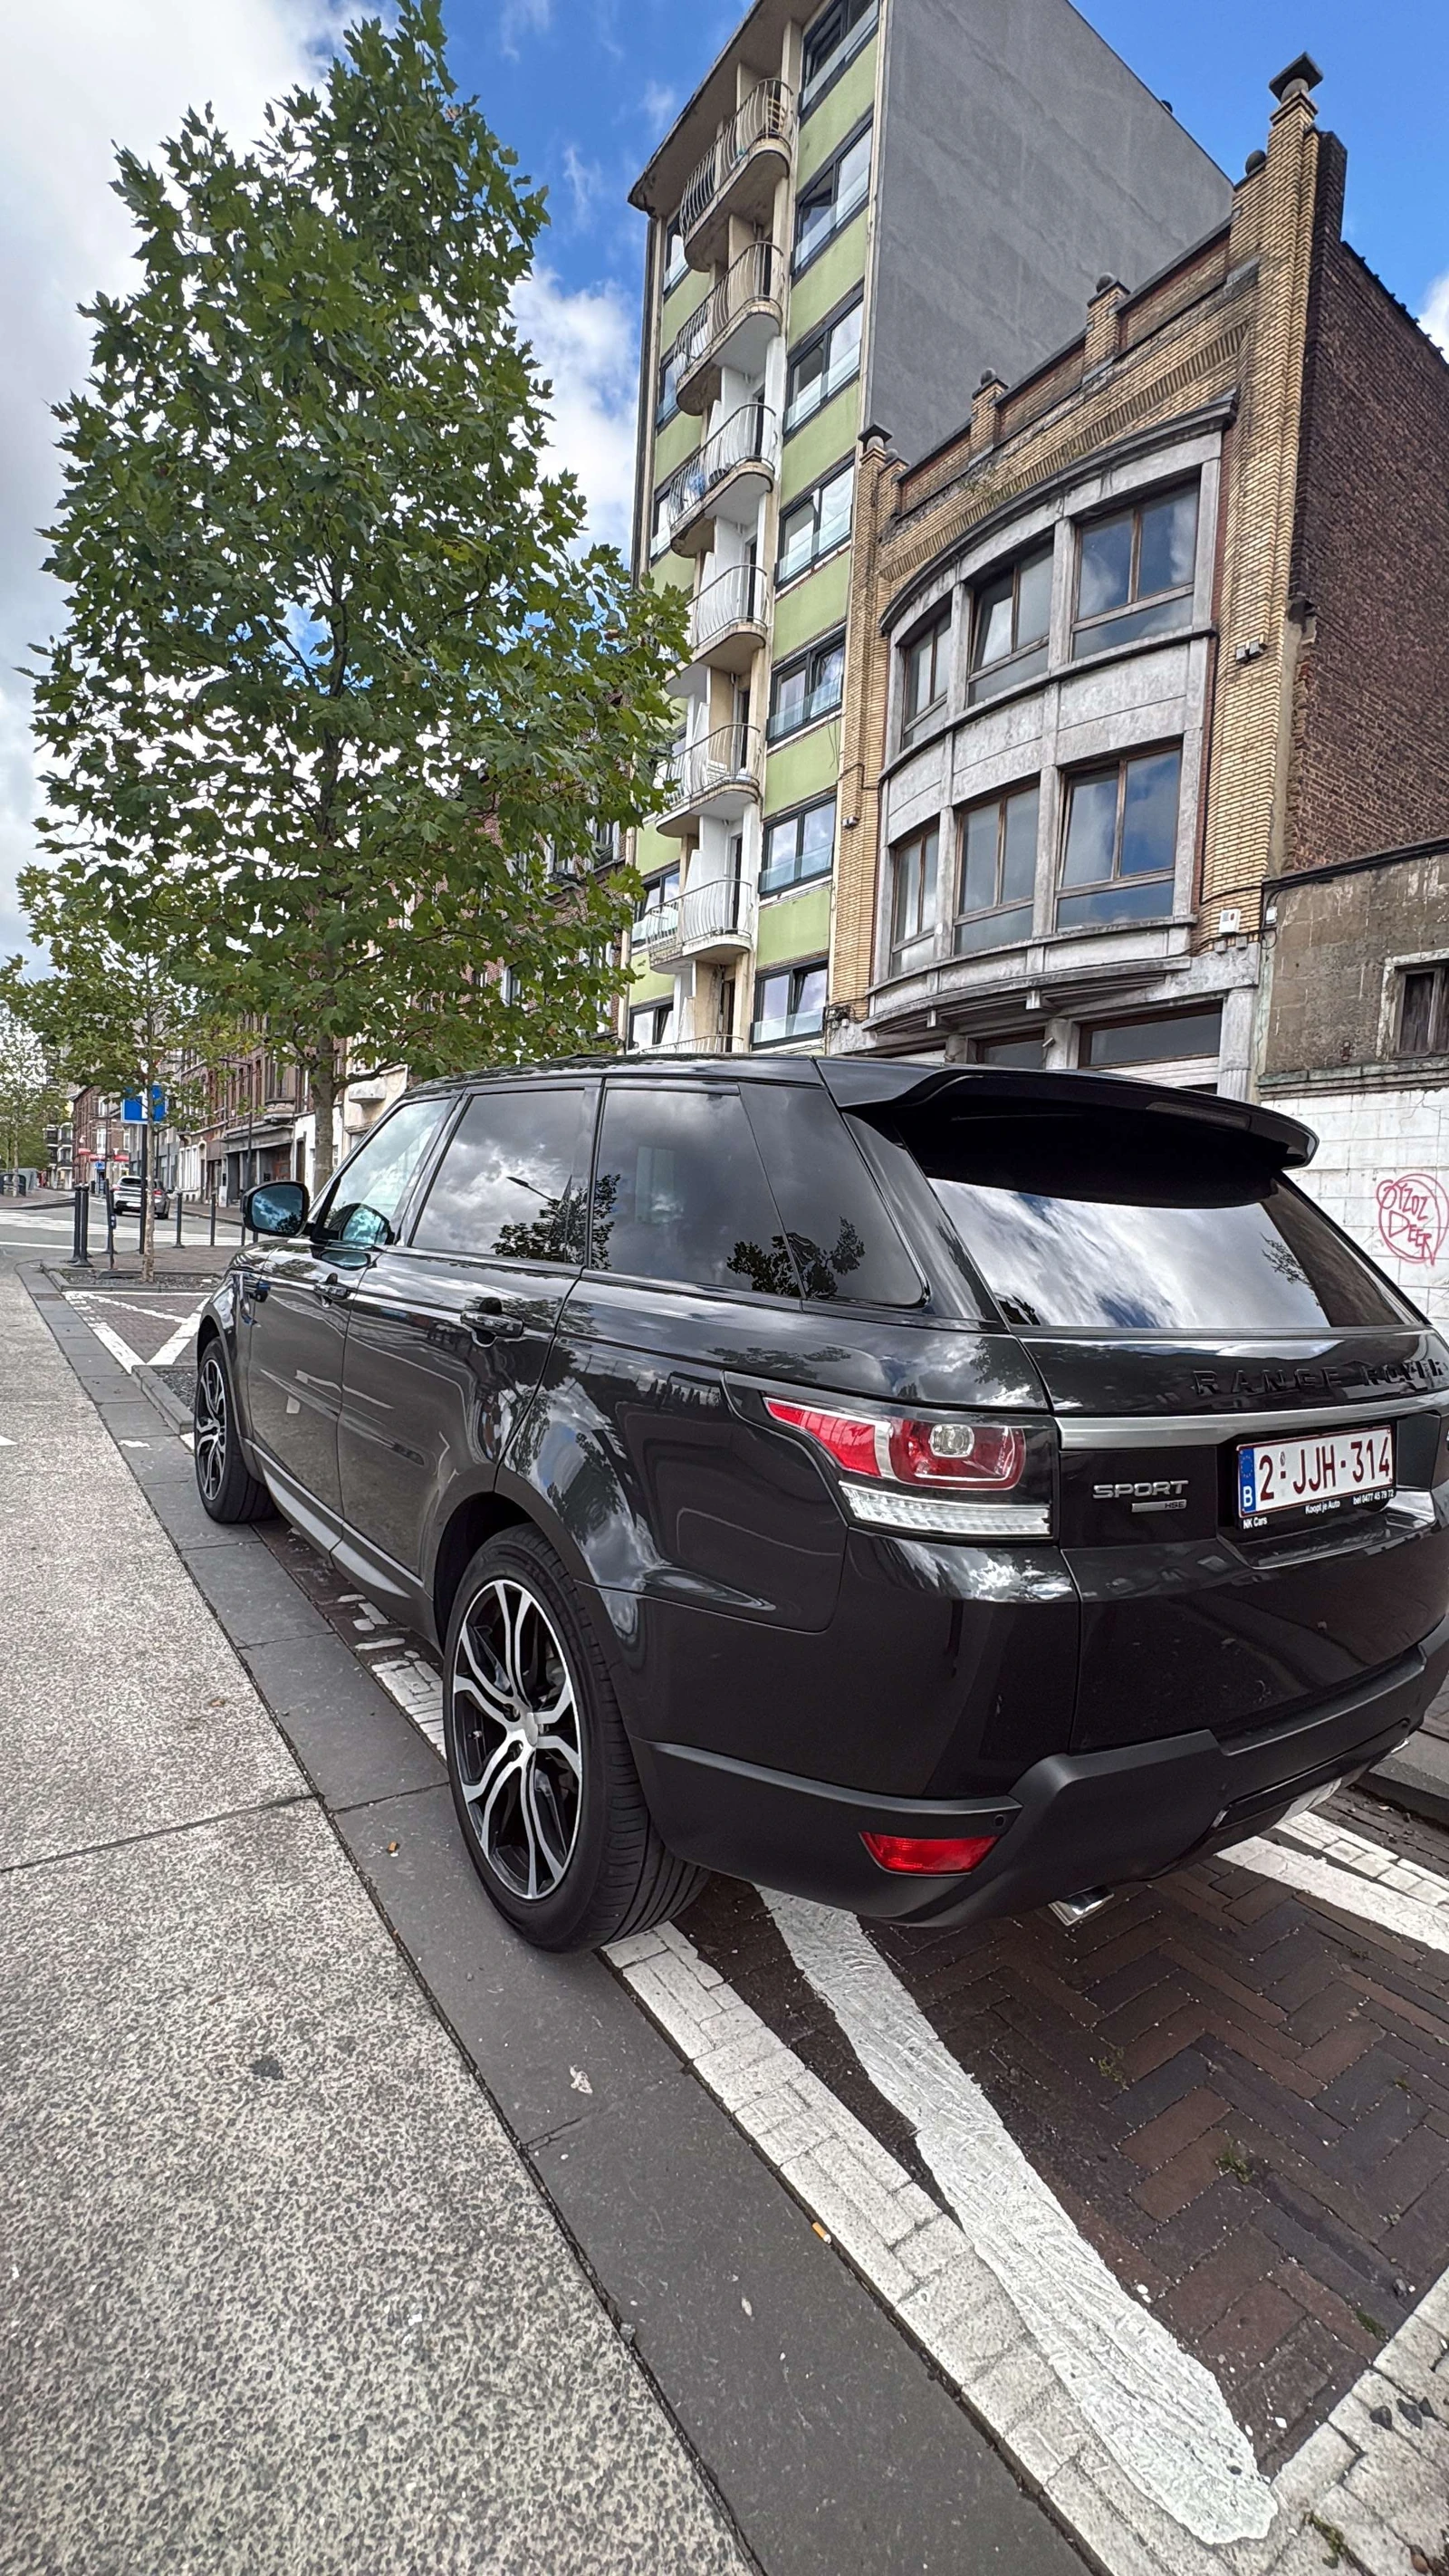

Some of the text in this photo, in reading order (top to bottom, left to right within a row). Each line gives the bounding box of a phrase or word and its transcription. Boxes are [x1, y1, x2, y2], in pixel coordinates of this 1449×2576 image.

[1192, 1359, 1448, 1396] RANGE ROVER
[1092, 1480, 1189, 1499] SPORT
[1243, 1485, 1253, 1507] B
[1165, 1501, 1185, 1509] HSE
[1243, 1518, 1253, 1530] NK
[1253, 1516, 1268, 1527] Cars
[1305, 1503, 1322, 1514] Koopt
[1321, 1501, 1328, 1514] je
[1328, 1500, 1340, 1509] Auto
[1353, 1495, 1362, 1505] bel
[1362, 1492, 1374, 1504] 0477
[1387, 1488, 1395, 1498] 72
